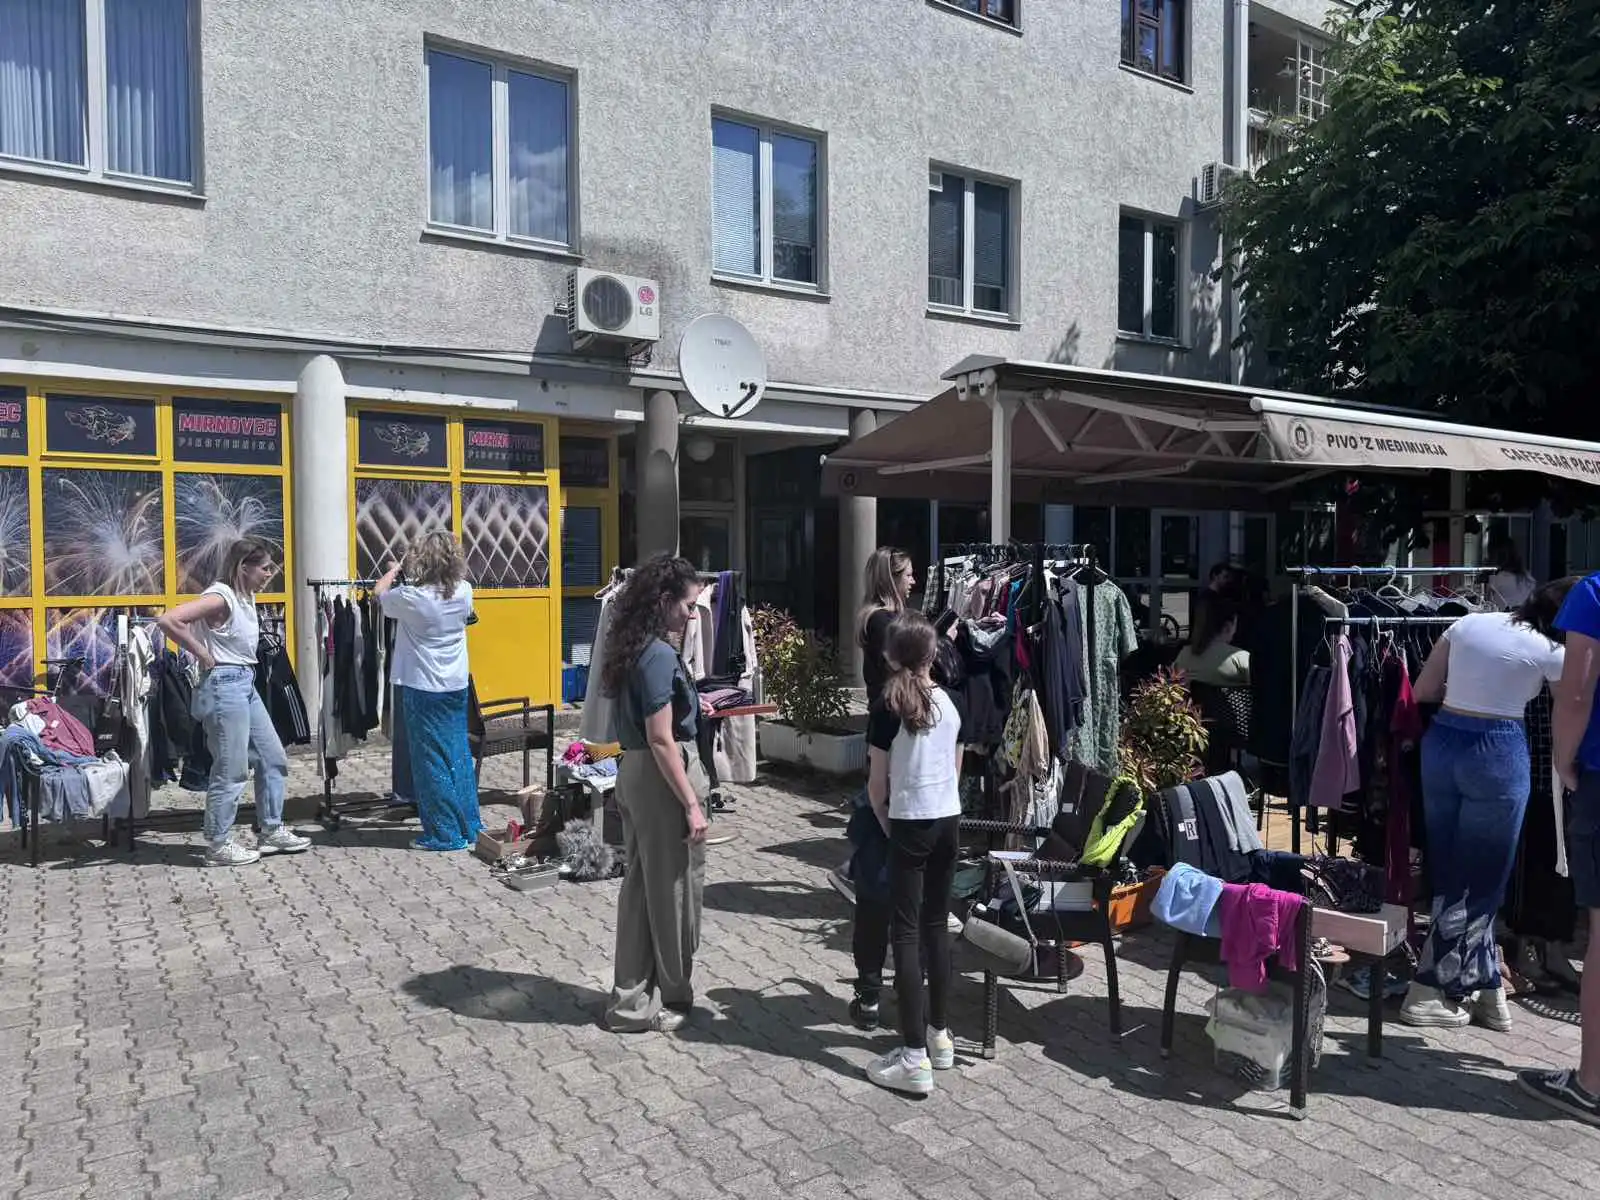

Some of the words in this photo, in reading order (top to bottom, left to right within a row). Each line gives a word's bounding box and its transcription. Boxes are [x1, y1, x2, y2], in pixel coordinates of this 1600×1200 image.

[639, 306, 653, 316] LG
[179, 413, 277, 436] MIRNOVEC
[1326, 434, 1358, 449] PIVO
[1501, 447, 1547, 465] CAFFE
[1545, 453, 1573, 470] BAR
